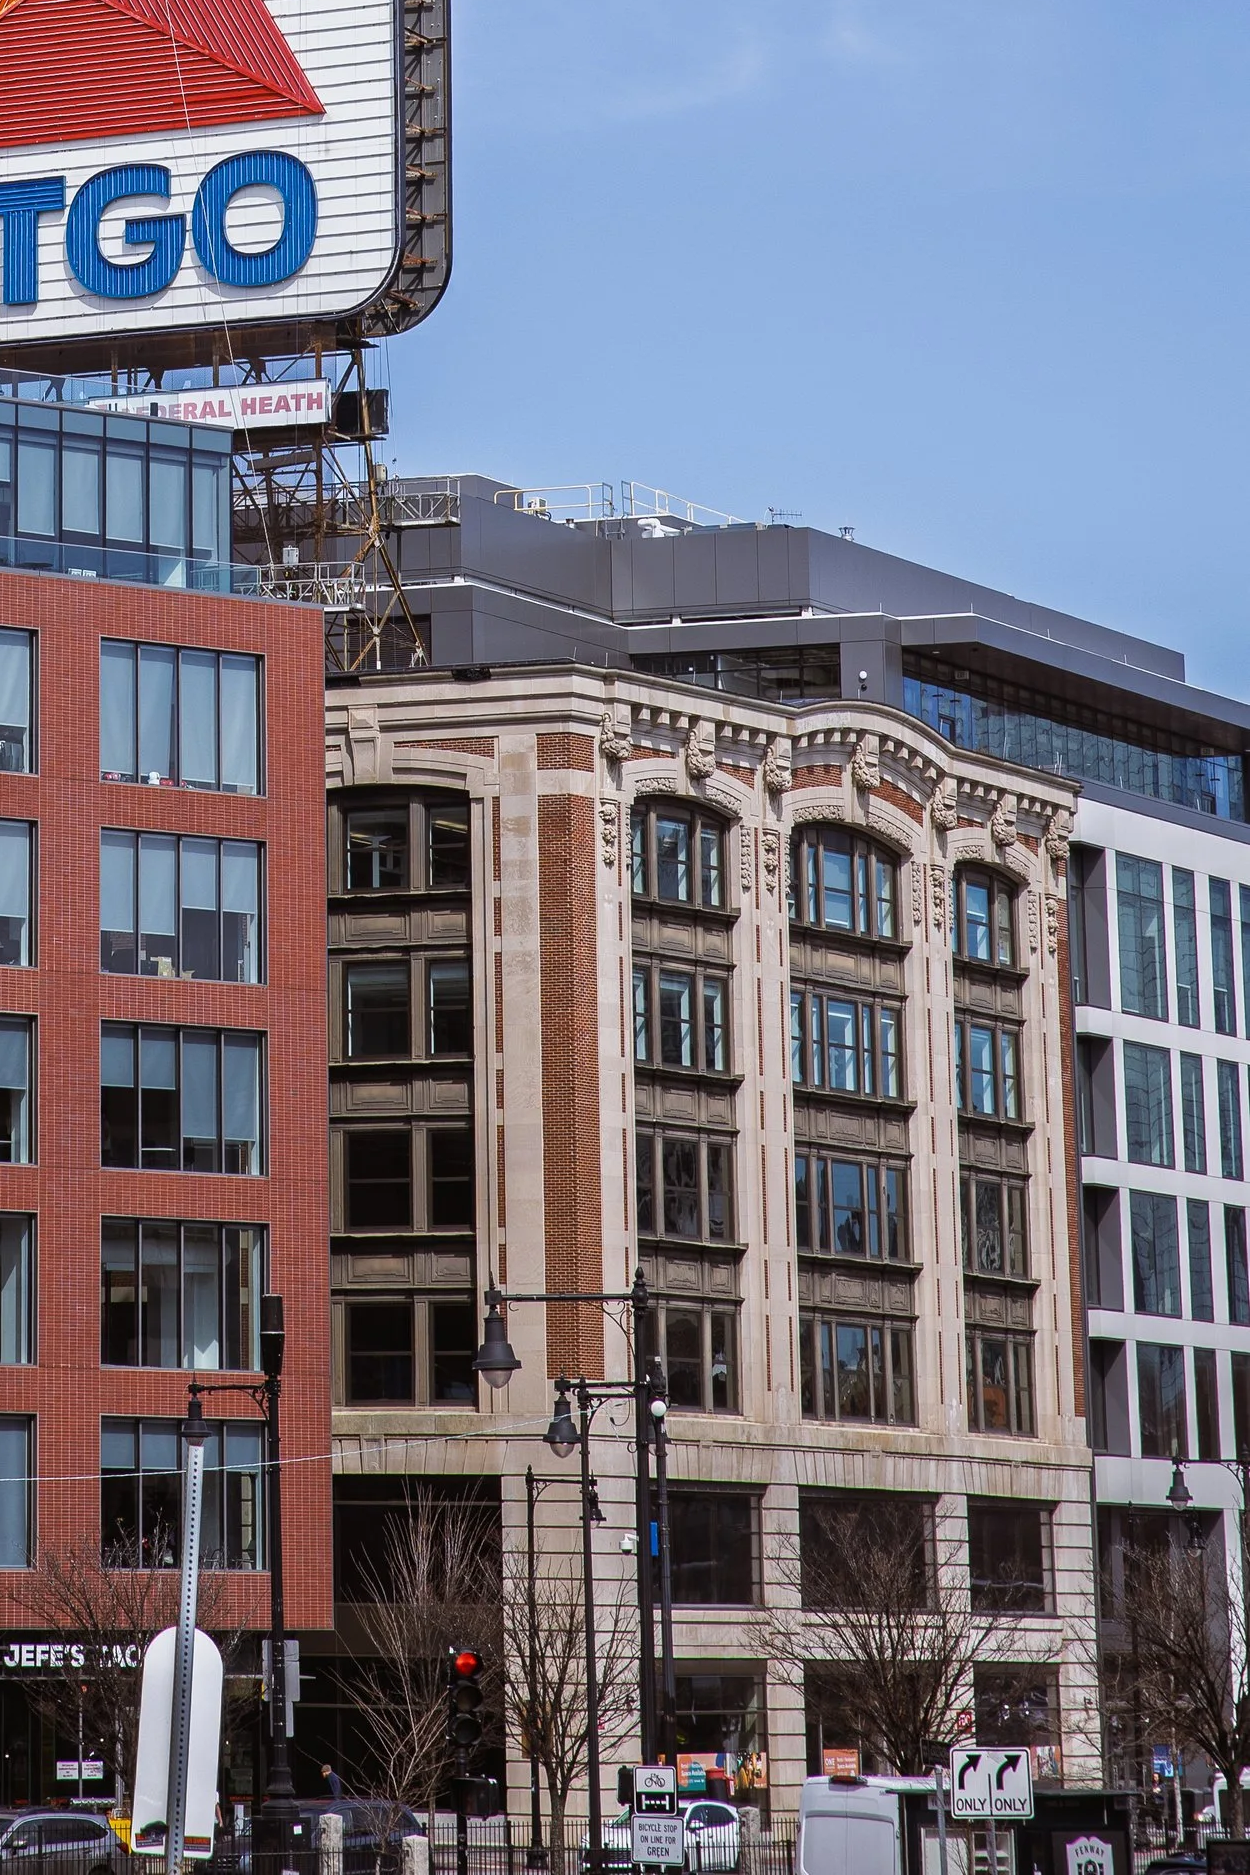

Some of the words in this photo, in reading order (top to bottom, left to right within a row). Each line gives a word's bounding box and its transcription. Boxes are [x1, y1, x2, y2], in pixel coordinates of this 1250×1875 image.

[240, 391, 324, 415] HEATH
[3, 1644, 84, 1667] JEFE'S
[956, 1798, 987, 1811] ONLY
[994, 1798, 1027, 1812] ONLY
[638, 1823, 661, 1832] BICYCLE
[663, 1824, 678, 1833] STOP
[640, 1835, 648, 1843] ON
[650, 1836, 663, 1844] LINE
[665, 1836, 676, 1845] FOR
[647, 1846, 669, 1857] GREEN
[1075, 1844, 1104, 1857] FENWAY
